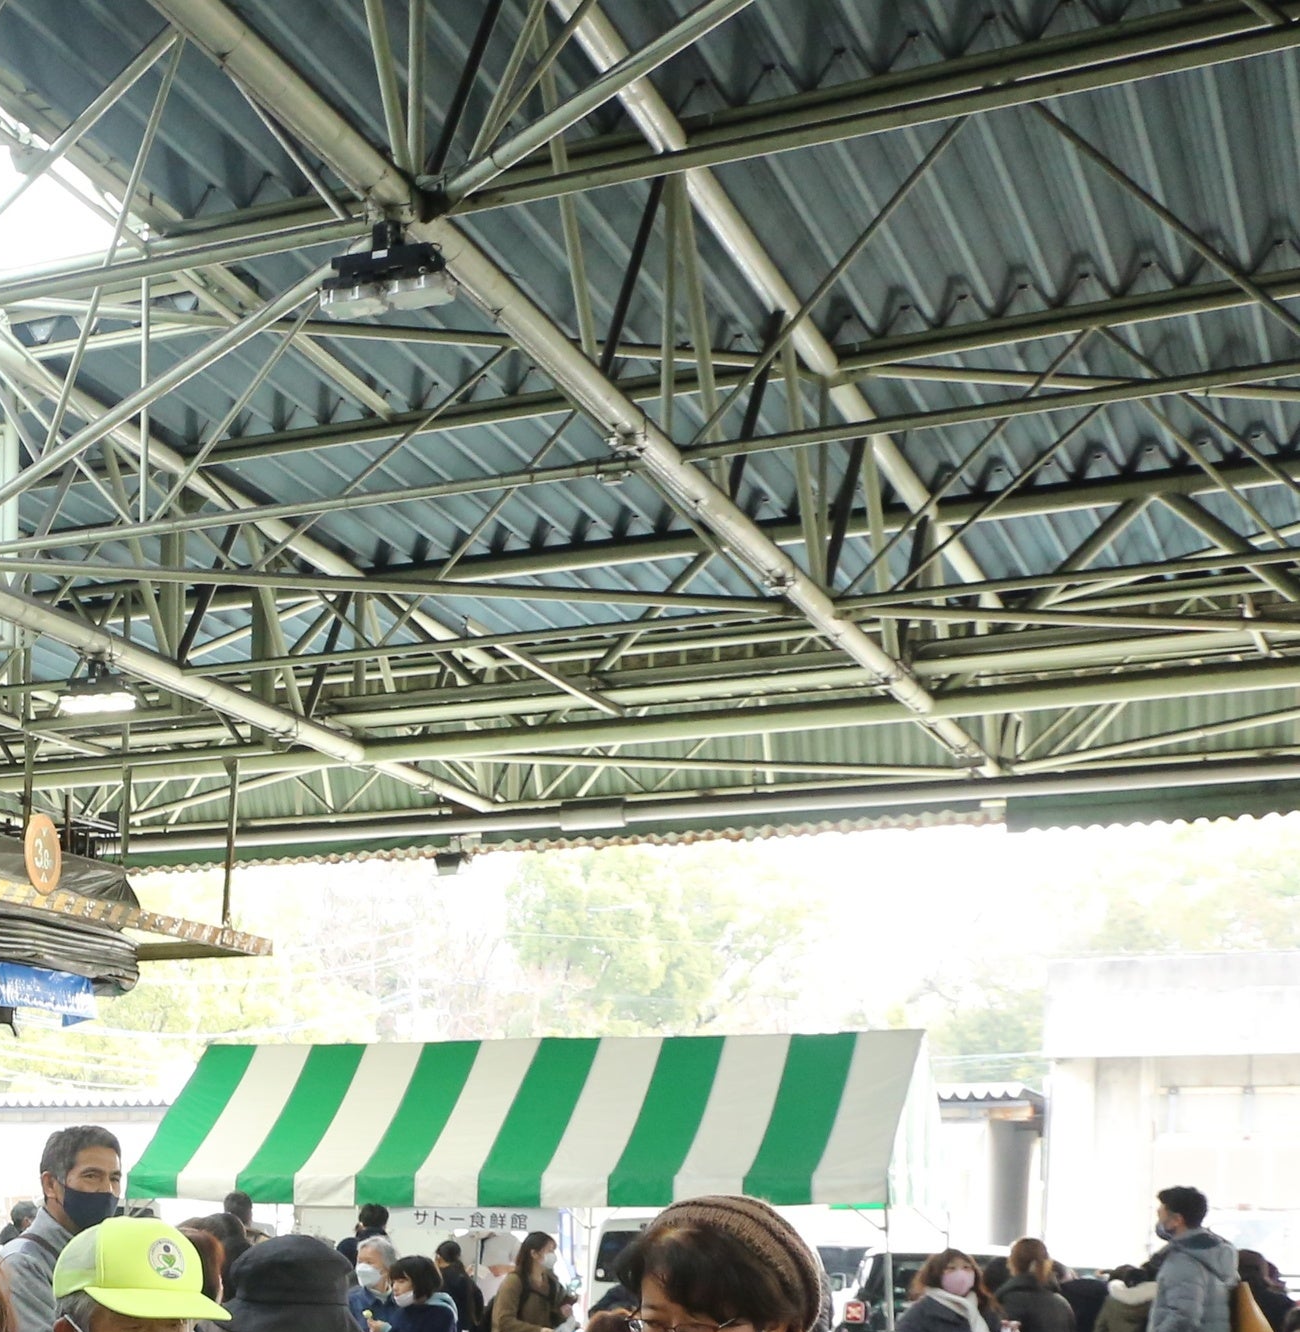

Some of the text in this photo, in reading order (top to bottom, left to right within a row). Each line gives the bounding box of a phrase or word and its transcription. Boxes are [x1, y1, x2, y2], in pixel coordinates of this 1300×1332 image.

[413, 1209, 529, 1230] サトー食鮮館
